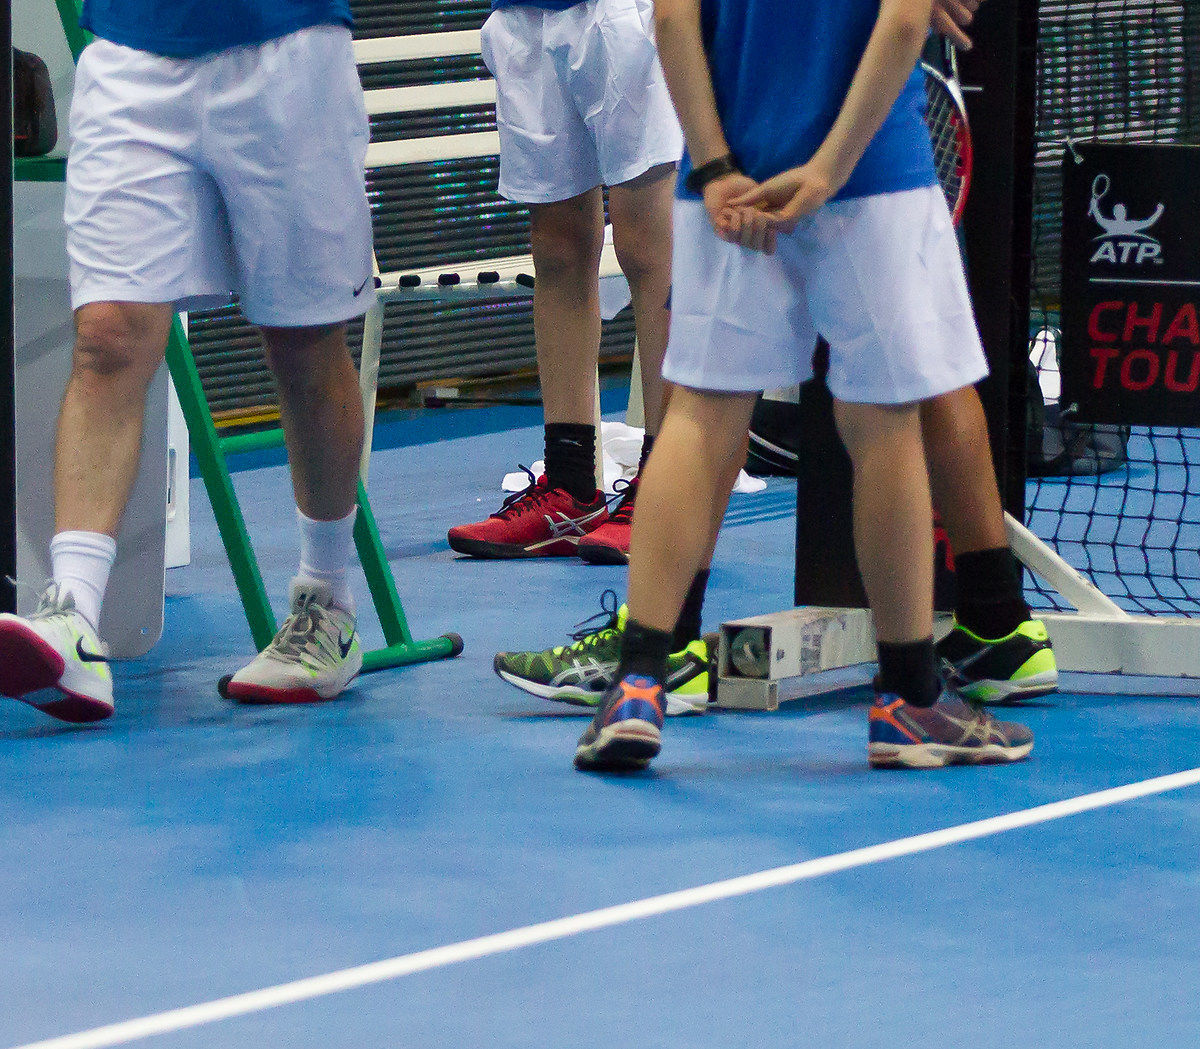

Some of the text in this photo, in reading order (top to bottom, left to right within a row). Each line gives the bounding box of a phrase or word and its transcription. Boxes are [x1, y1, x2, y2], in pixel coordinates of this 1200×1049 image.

[1090, 241, 1162, 264] ATP
[1087, 301, 1200, 345] CHA
[1089, 349, 1200, 392] TOU
